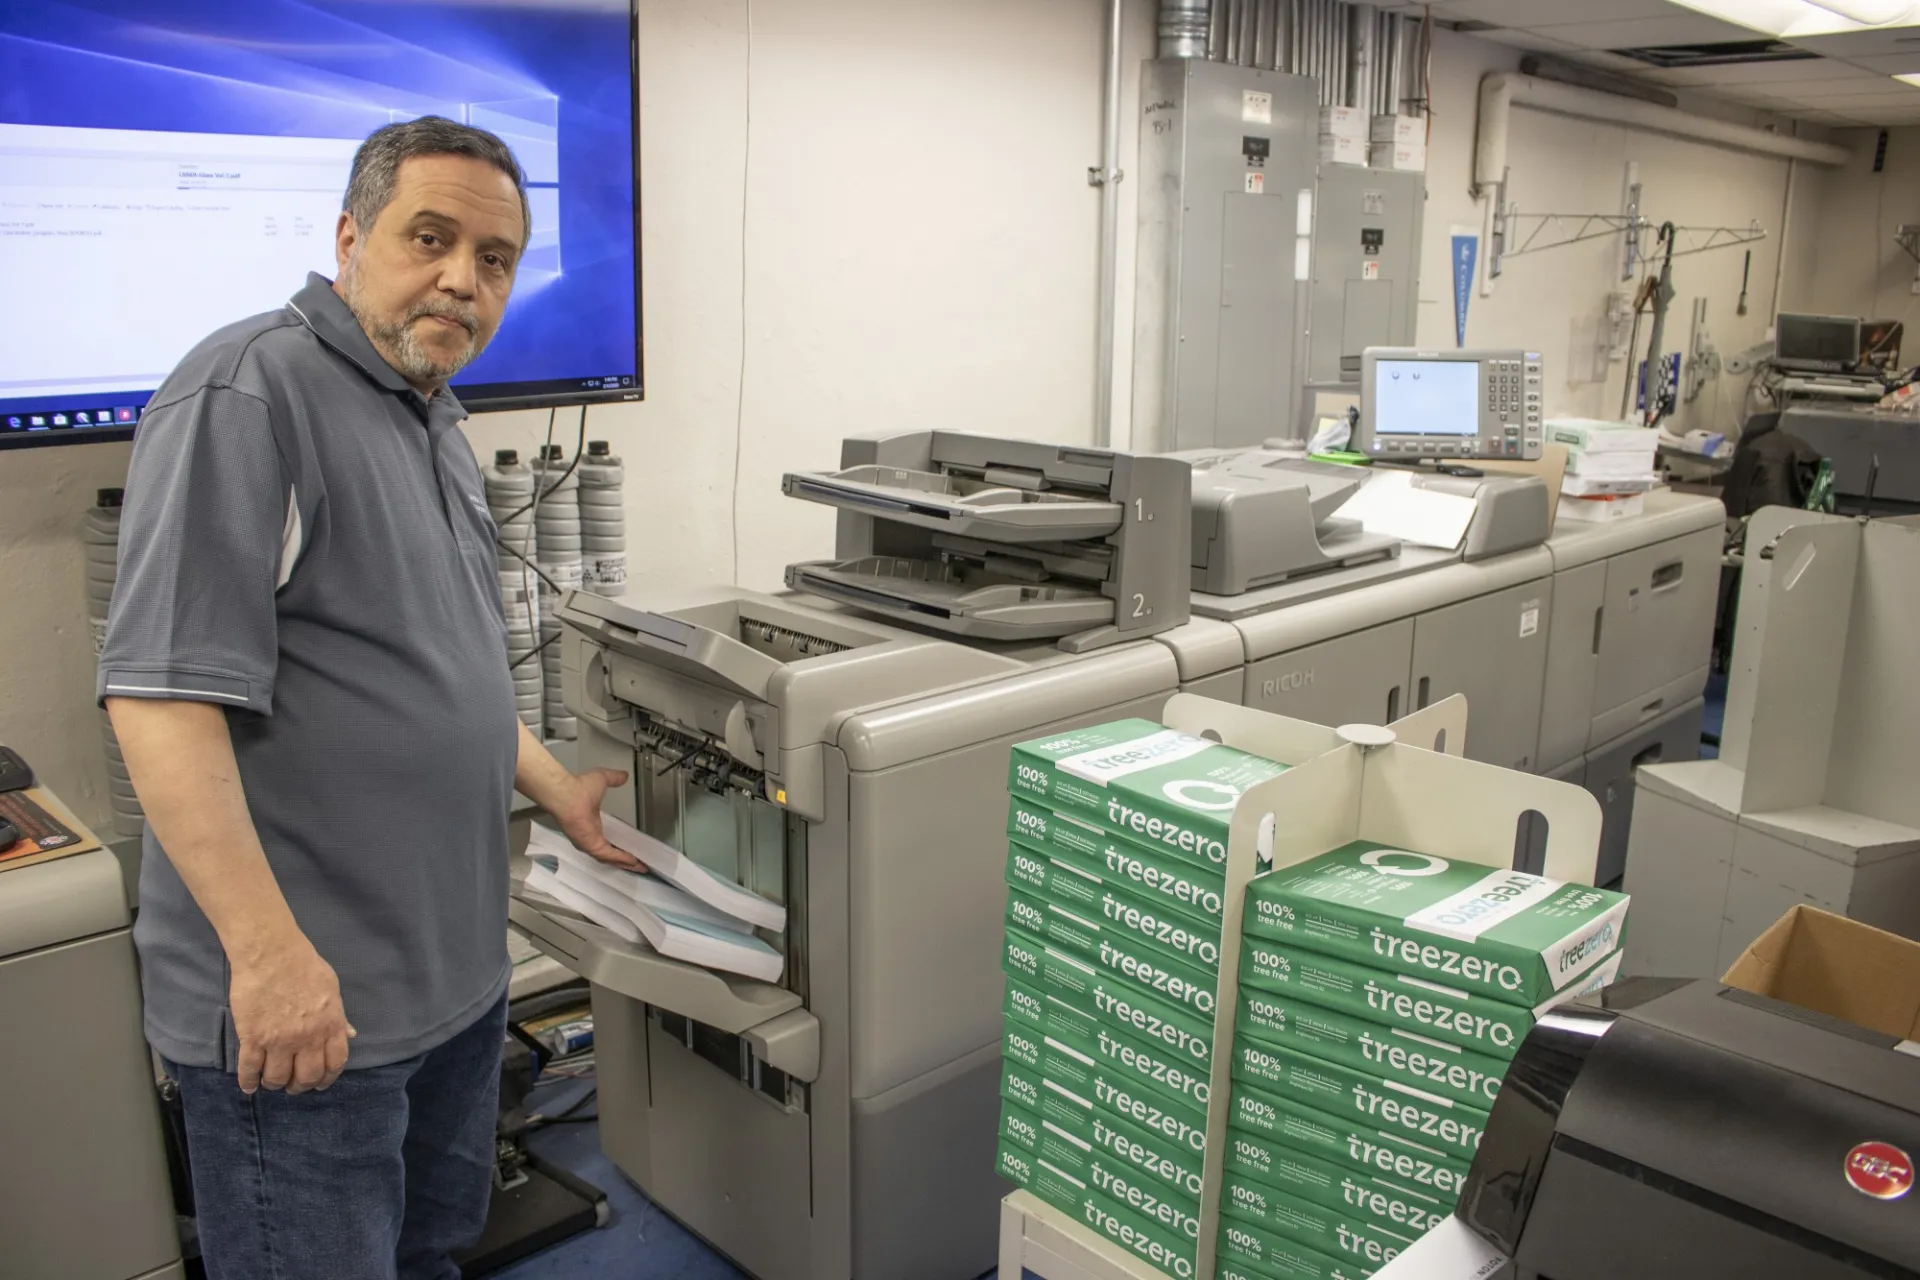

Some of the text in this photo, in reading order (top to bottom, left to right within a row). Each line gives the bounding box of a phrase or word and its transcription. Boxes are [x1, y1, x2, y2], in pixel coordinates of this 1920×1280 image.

[1262, 668, 1315, 699] RICOH
[1016, 764, 1048, 786] 100%
[1017, 778, 1030, 789] tree
[1032, 784, 1046, 795] free
[1016, 810, 1046, 832] 100%
[1016, 824, 1044, 840] tree free
[1108, 797, 1226, 863] treezero
[1014, 856, 1045, 878] 100%
[1014, 868, 1042, 886] tree free
[1104, 846, 1222, 914] treezero
[1013, 901, 1042, 924] 100%
[1256, 900, 1295, 920] 100%
[1436, 876, 1546, 926] treezero
[1012, 914, 1040, 932] tree free
[1102, 892, 1218, 964] treezero
[1258, 914, 1294, 930] tree free
[1008, 944, 1037, 968] 100%
[1370, 926, 1523, 990] treezero
[1560, 922, 1613, 974] treezero
[1008, 957, 1036, 976] tree free
[1252, 950, 1290, 972] 100%
[1100, 940, 1214, 1012] treezero
[1254, 964, 1289, 982] tree free
[1010, 990, 1041, 1012] 100%
[1012, 1002, 1040, 1020] tree free
[1248, 1000, 1286, 1022] 100%
[1093, 985, 1208, 1058] treezero
[1250, 1014, 1285, 1031] tree free
[1364, 980, 1514, 1047] treezero
[1008, 1034, 1038, 1056] 100%
[1009, 1046, 1036, 1064] tree free
[1098, 1030, 1210, 1102] treezero
[1244, 1048, 1281, 1072] 100%
[1244, 1063, 1260, 1075] tree
[1262, 1068, 1279, 1080] free
[1358, 1032, 1502, 1100] treezero
[1008, 1074, 1037, 1098] 100%
[1008, 1086, 1035, 1106] tree free
[1094, 1076, 1206, 1150] treezero
[1239, 1096, 1276, 1120] 100%
[1007, 1116, 1036, 1140] 100%
[1240, 1112, 1256, 1124] tree
[1257, 1118, 1273, 1130] free
[1007, 1128, 1034, 1148] tree free
[1092, 1119, 1202, 1194] treezero
[1234, 1140, 1270, 1164] 100%
[1236, 1154, 1270, 1172] tree free
[1002, 1152, 1030, 1176] 100%
[1002, 1164, 1028, 1184] tree free
[1346, 1134, 1468, 1196] treezer
[1091, 1162, 1200, 1238] treezero
[1231, 1185, 1266, 1208] 100%
[1232, 1198, 1266, 1217] tree free
[1341, 1178, 1444, 1232] treeze
[1084, 1199, 1192, 1278] treezero
[1226, 1228, 1262, 1252] 100%
[1336, 1224, 1400, 1264] tree
[1228, 1242, 1261, 1260] tree free
